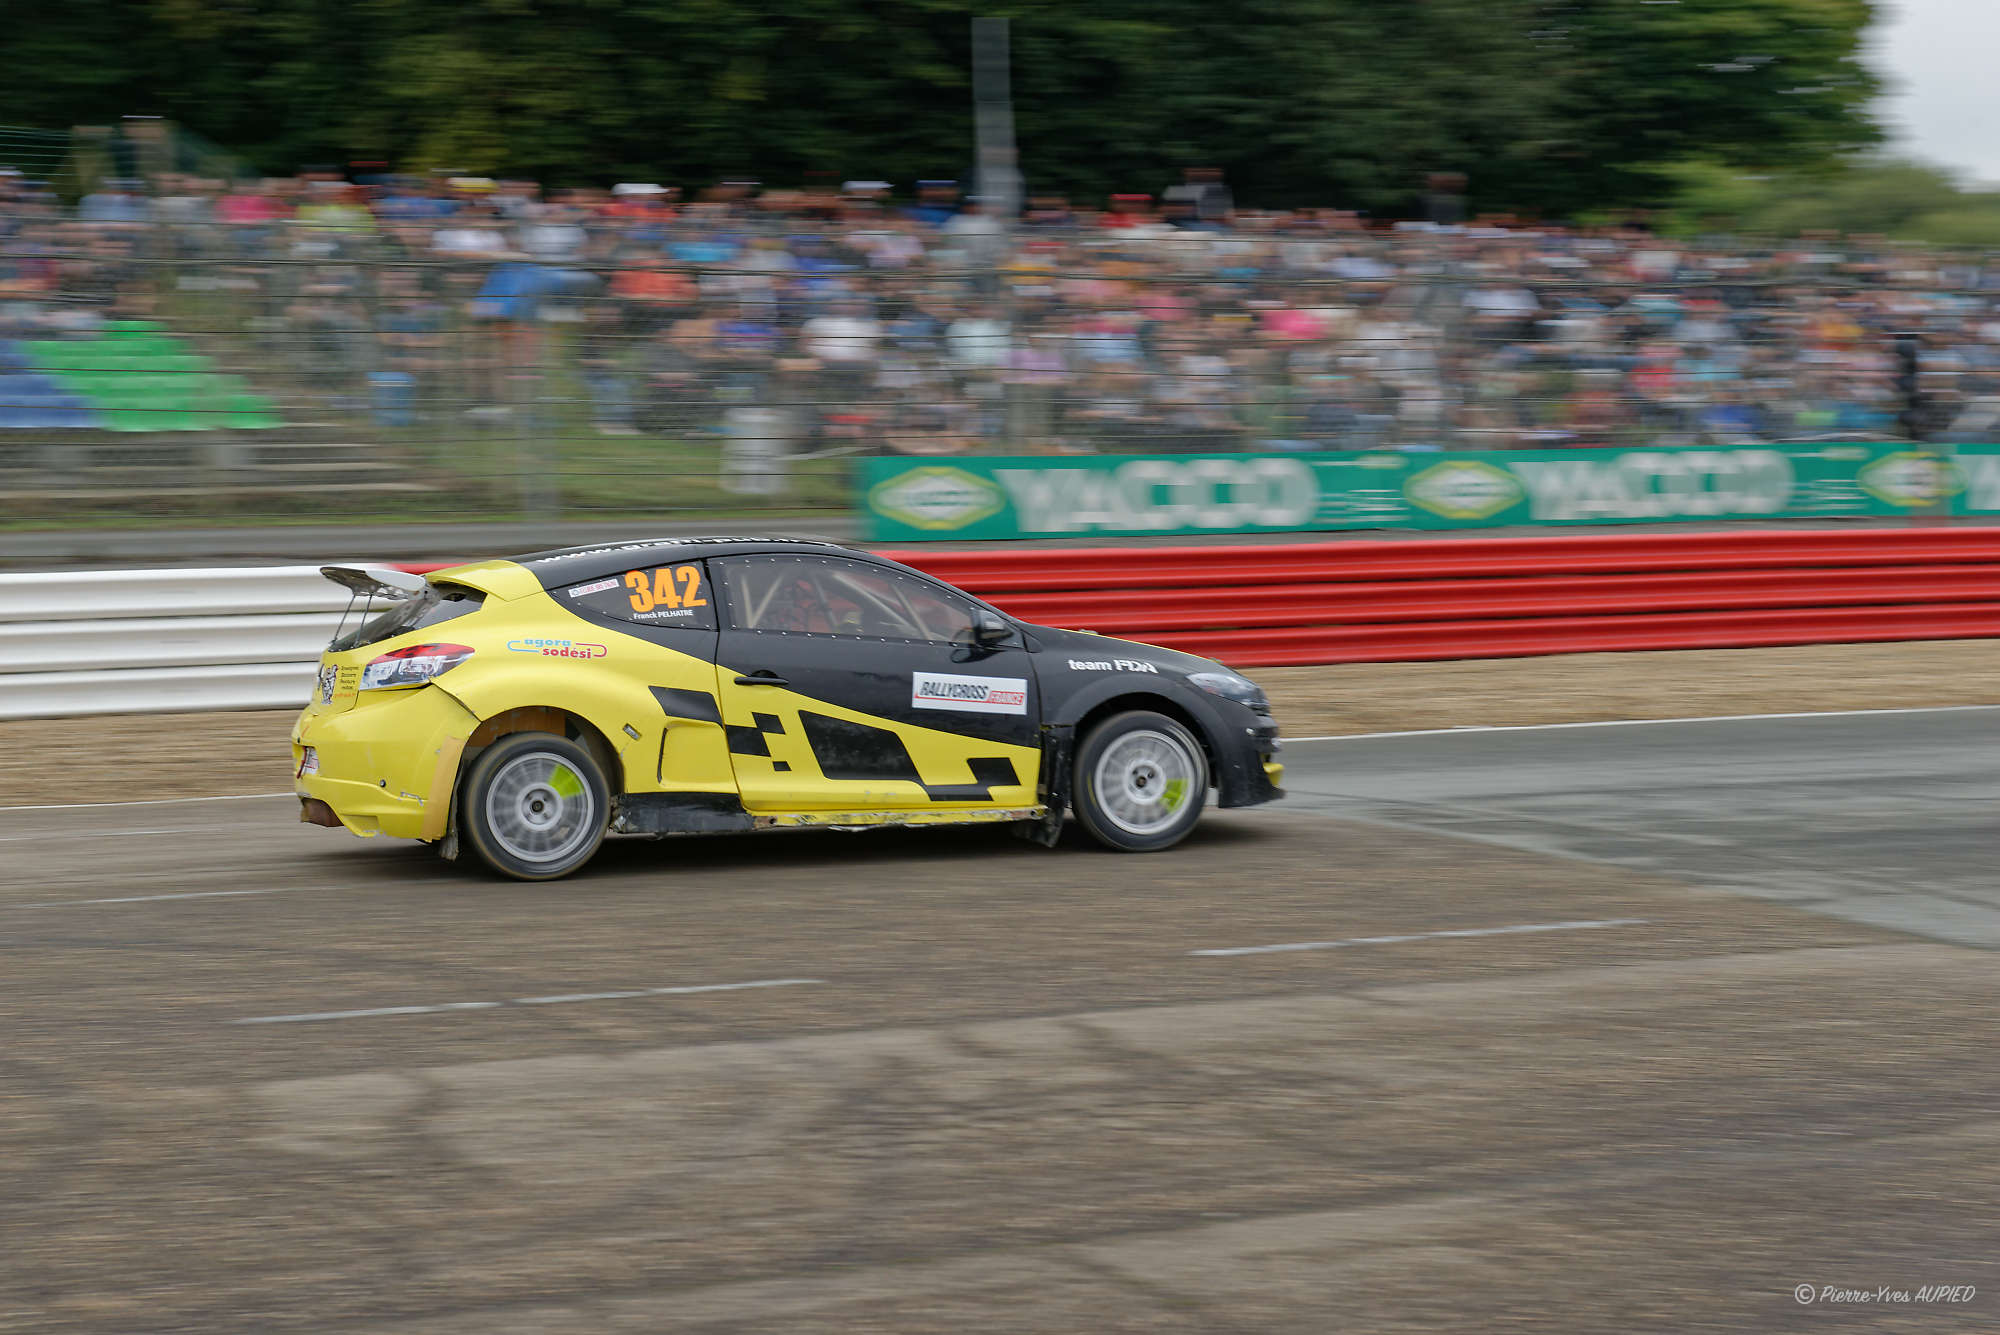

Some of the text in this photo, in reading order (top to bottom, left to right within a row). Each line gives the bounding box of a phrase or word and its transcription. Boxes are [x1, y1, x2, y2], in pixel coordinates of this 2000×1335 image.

[624, 565, 707, 613] 342
[633, 609, 693, 620] Franck PELHATRE
[523, 638, 571, 648] agora
[542, 647, 592, 659] sodési
[1067, 659, 1112, 671] team
[919, 681, 989, 700] RALLYCROSS
